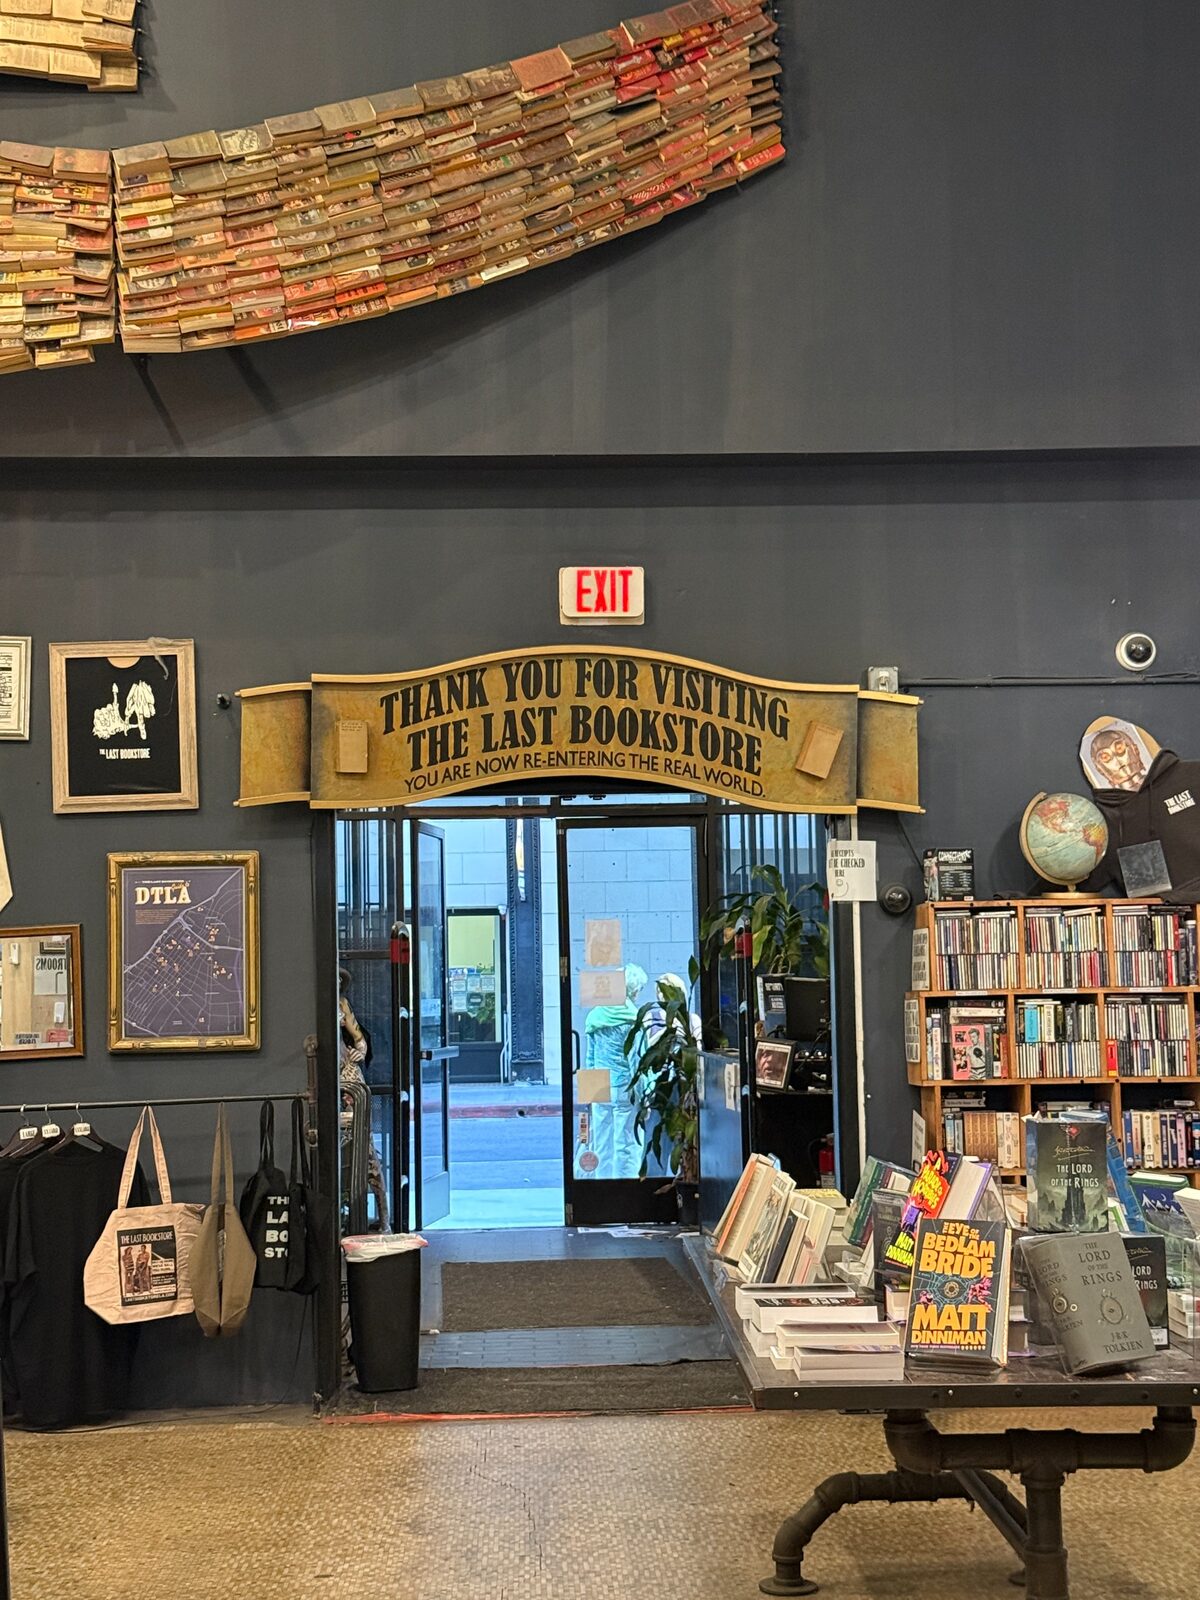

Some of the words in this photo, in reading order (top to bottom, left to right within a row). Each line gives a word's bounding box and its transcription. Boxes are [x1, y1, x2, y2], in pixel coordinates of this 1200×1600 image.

[576, 569, 633, 613] EXIT
[380, 667, 489, 735] THANK
[501, 659, 563, 702] YOU
[575, 658, 638, 700] FOR
[651, 663, 790, 741] VISITING
[407, 718, 469, 772] THE
[481, 706, 557, 753] LAST
[569, 705, 762, 776] BOOKSTORE
[105, 748, 119, 760] LAST
[120, 747, 151, 759] BOOKSTORE
[405, 770, 438, 793] YOU
[441, 763, 471, 784] ARE
[476, 754, 519, 776] NOW
[524, 750, 626, 769] RE-ENTERING
[629, 753, 659, 772] THE
[664, 758, 700, 780] REAL
[704, 766, 766, 798] WORLD.
[1174, 790, 1191, 804] LAST
[840, 858, 866, 868] CHECKED
[135, 886, 192, 905] DTLA
[933, 1156, 942, 1171] A
[1056, 1164, 1069, 1173] THE
[1071, 1163, 1093, 1174] LORD
[1050, 1179, 1059, 1187] OF
[1060, 1178, 1072, 1187] THE
[1074, 1177, 1099, 1188] RINGS
[267, 1196, 290, 1205] TH
[948, 1222, 970, 1237] EYE
[121, 1234, 130, 1245] THE
[131, 1233, 142, 1244] LAST
[142, 1230, 174, 1242] BOOKSTORE
[894, 1231, 914, 1252] MATT
[922, 1231, 996, 1258] BEDLAM
[264, 1247, 288, 1258] ST
[1078, 1249, 1111, 1263] LORD
[919, 1248, 994, 1279] BRIDE
[1131, 1265, 1152, 1276] LORD
[1081, 1270, 1123, 1287] RINGS
[1135, 1279, 1158, 1291] RINGS
[911, 1303, 992, 1331] MATT
[911, 1329, 987, 1346] DINNIMAN
[1103, 1340, 1145, 1354] TOLKIEN
